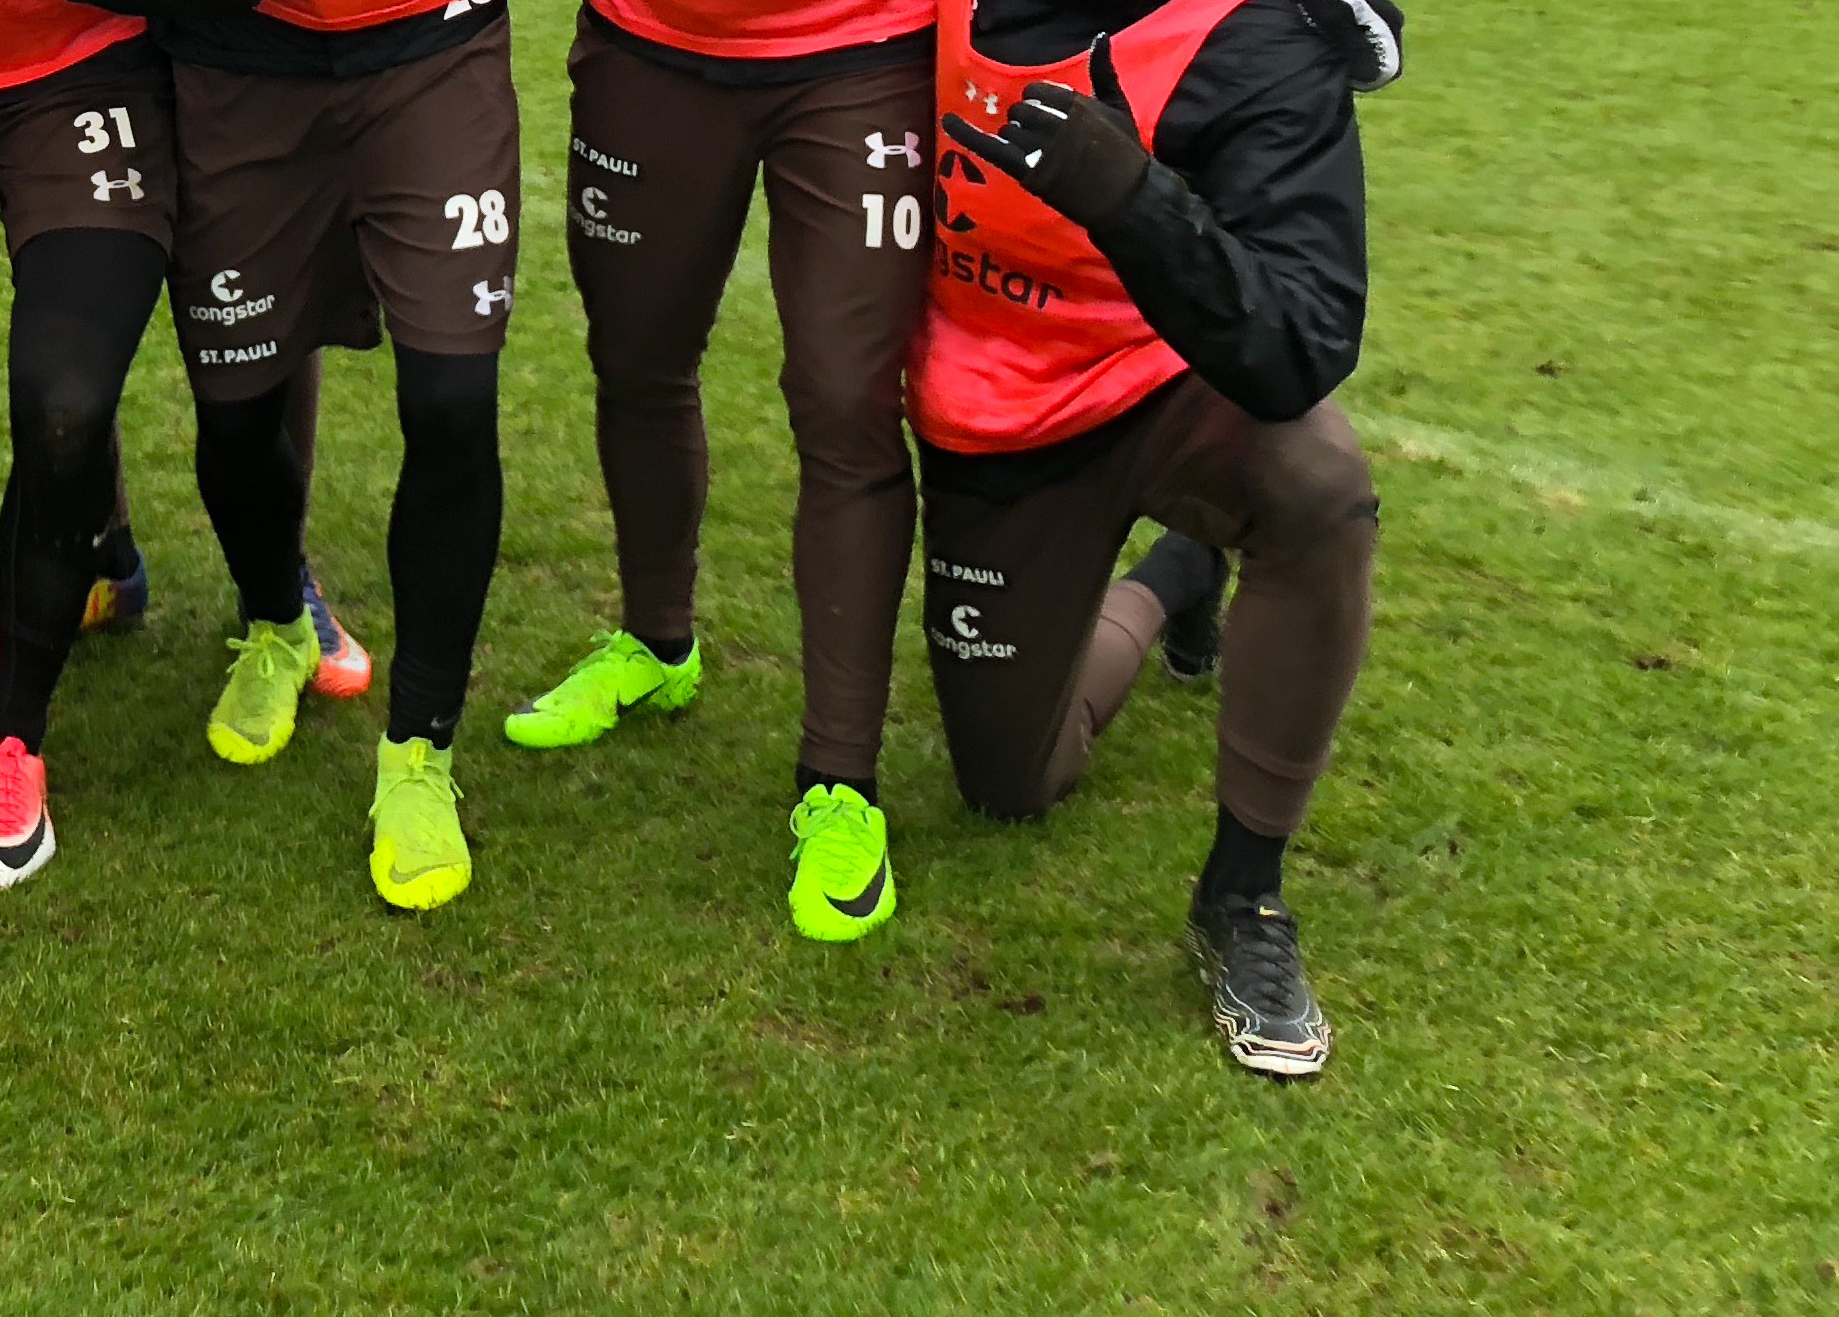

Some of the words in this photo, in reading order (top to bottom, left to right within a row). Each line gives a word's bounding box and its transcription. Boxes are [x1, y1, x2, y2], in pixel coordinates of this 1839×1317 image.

[73, 106, 136, 154] 31
[589, 148, 638, 177] PAULI
[444, 189, 509, 250] 28
[862, 194, 921, 250] 10
[189, 295, 275, 326] congstar
[199, 350, 222, 364] ST.
[224, 341, 277, 363] PAULI
[952, 565, 1005, 586] PAULI
